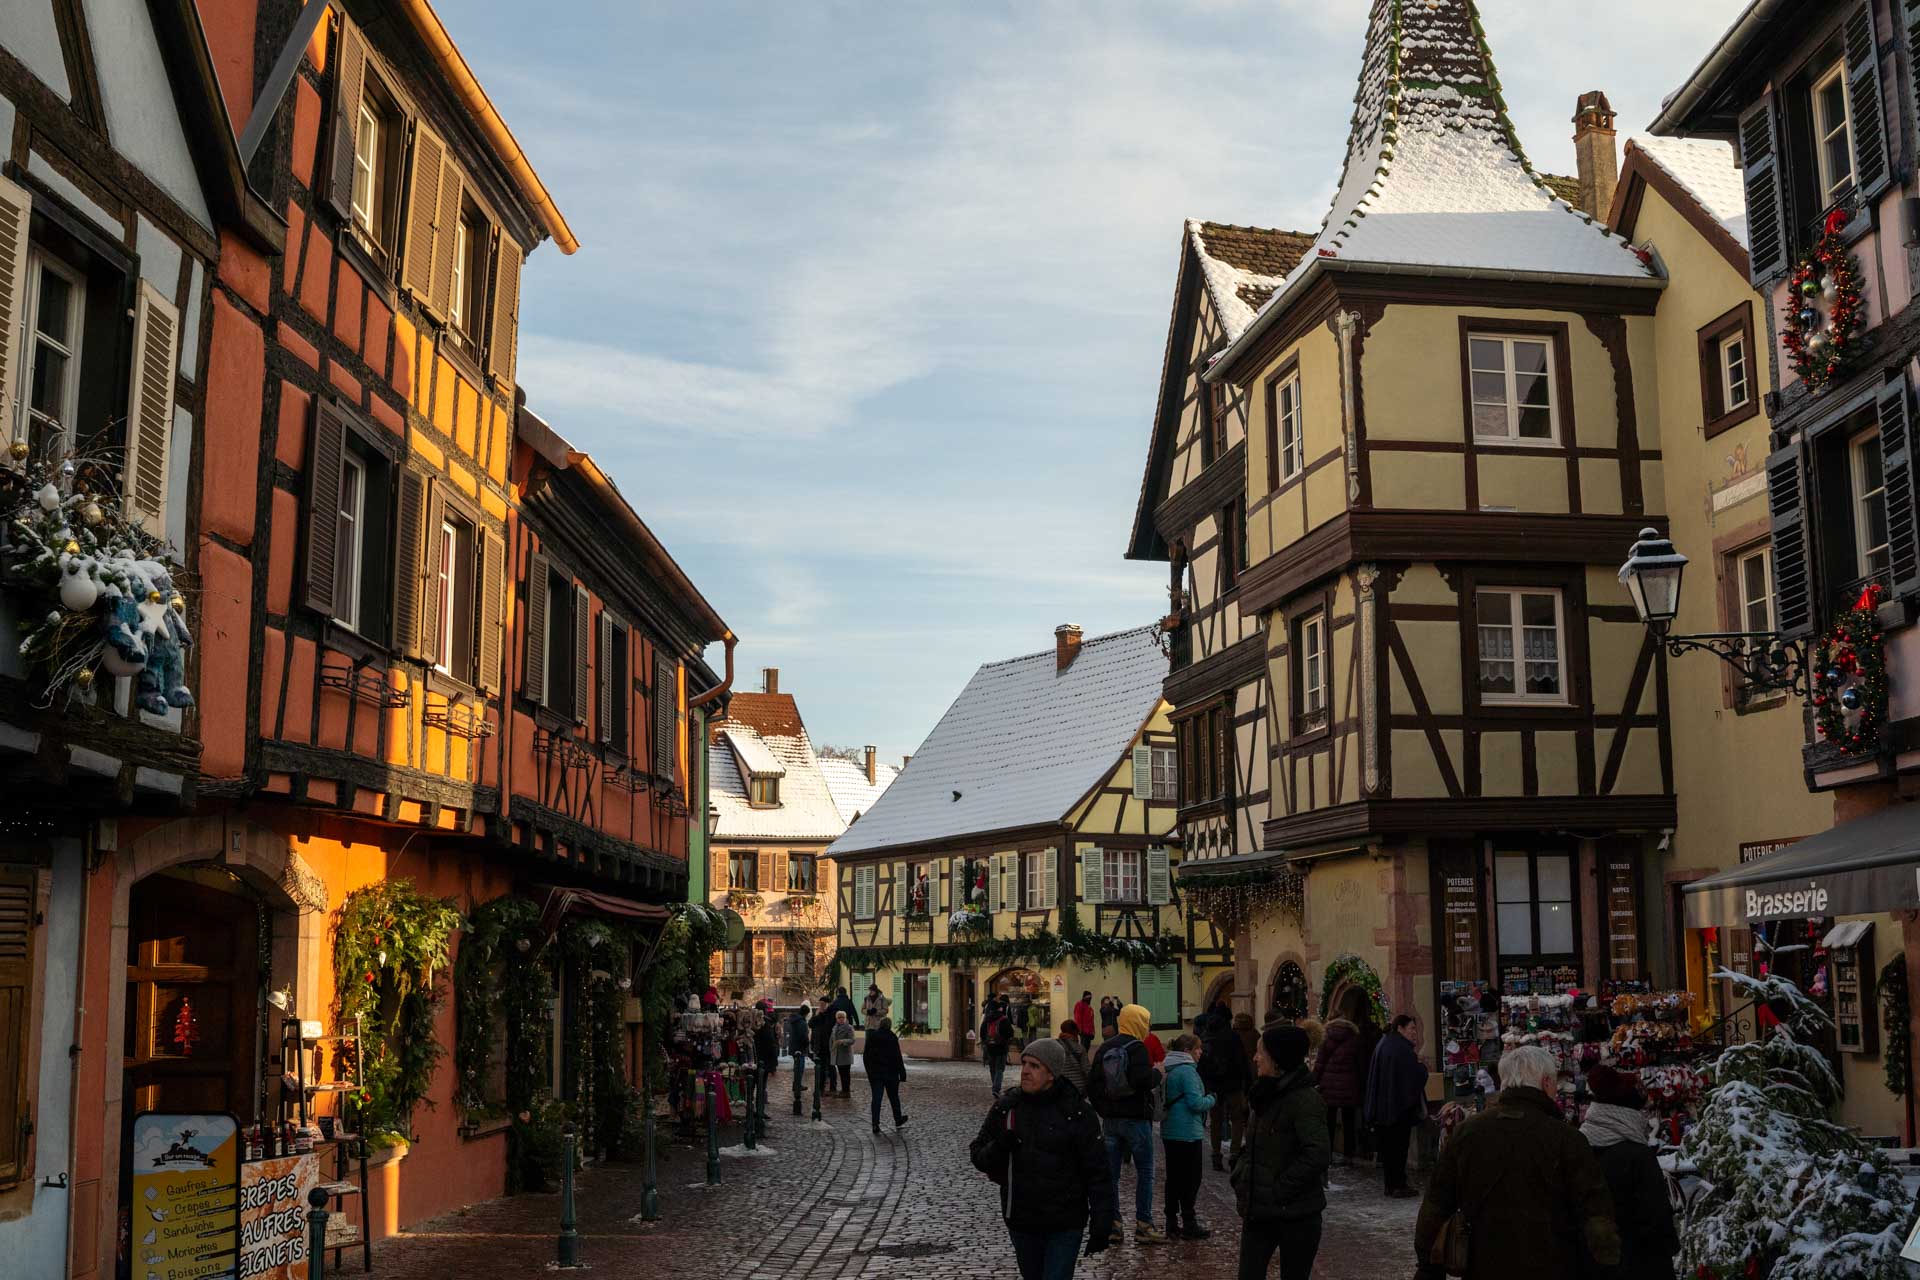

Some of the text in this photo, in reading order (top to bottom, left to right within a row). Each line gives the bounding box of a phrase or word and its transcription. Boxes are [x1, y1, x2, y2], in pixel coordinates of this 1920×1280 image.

[1447, 878, 1474, 886] POTERIES
[1745, 881, 1828, 918] Brasserie
[166, 1181, 206, 1195] Gaufres
[240, 1206, 305, 1246] AUFRES,
[168, 1242, 217, 1259] Moricettes
[168, 1263, 221, 1280] Boissons
